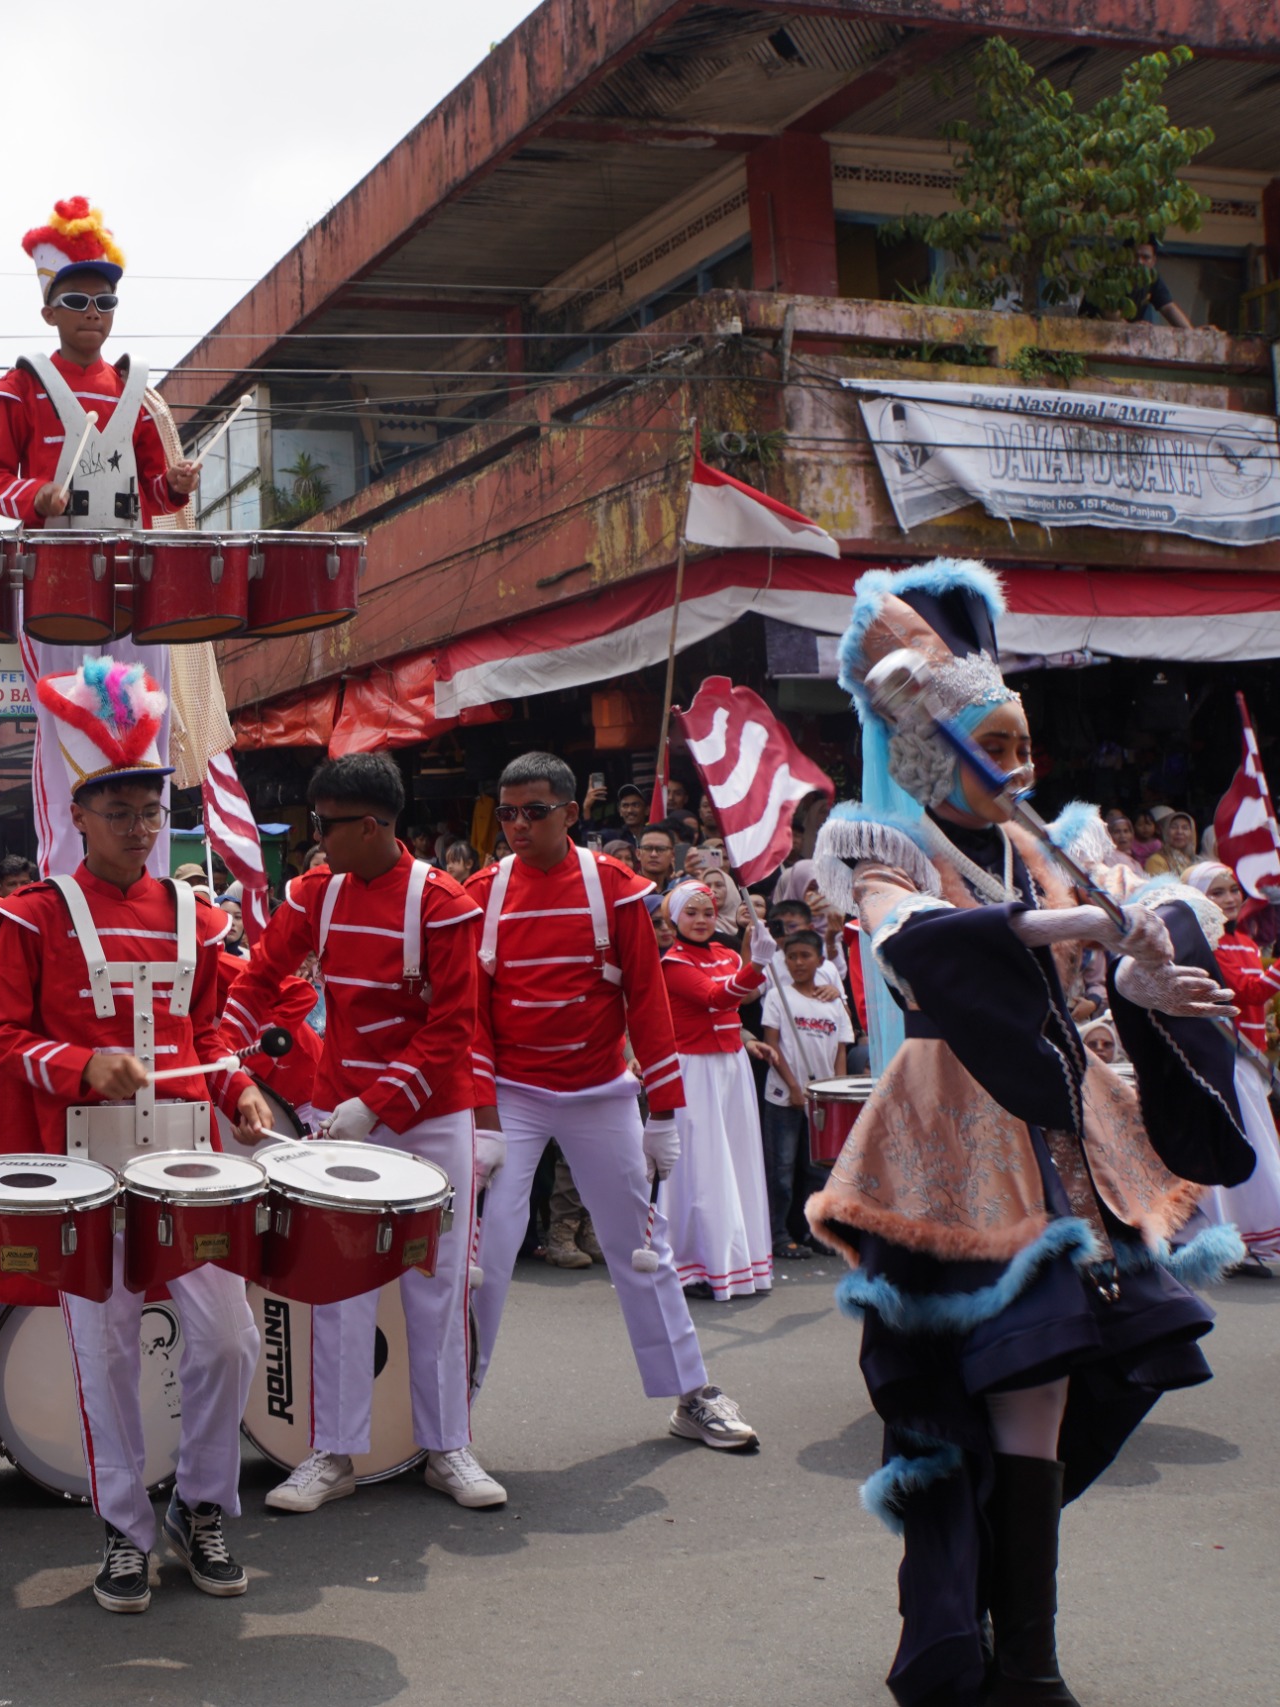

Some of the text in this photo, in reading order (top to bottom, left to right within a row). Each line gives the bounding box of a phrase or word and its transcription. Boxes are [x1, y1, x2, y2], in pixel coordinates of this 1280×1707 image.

[1016, 395, 1106, 418] Nasional
[983, 422, 1085, 484] DAMAI
[1088, 428, 1202, 498] BUSANA
[1057, 499, 1077, 510] No.
[1100, 501, 1129, 516] Padang
[1130, 506, 1168, 520] Panjang
